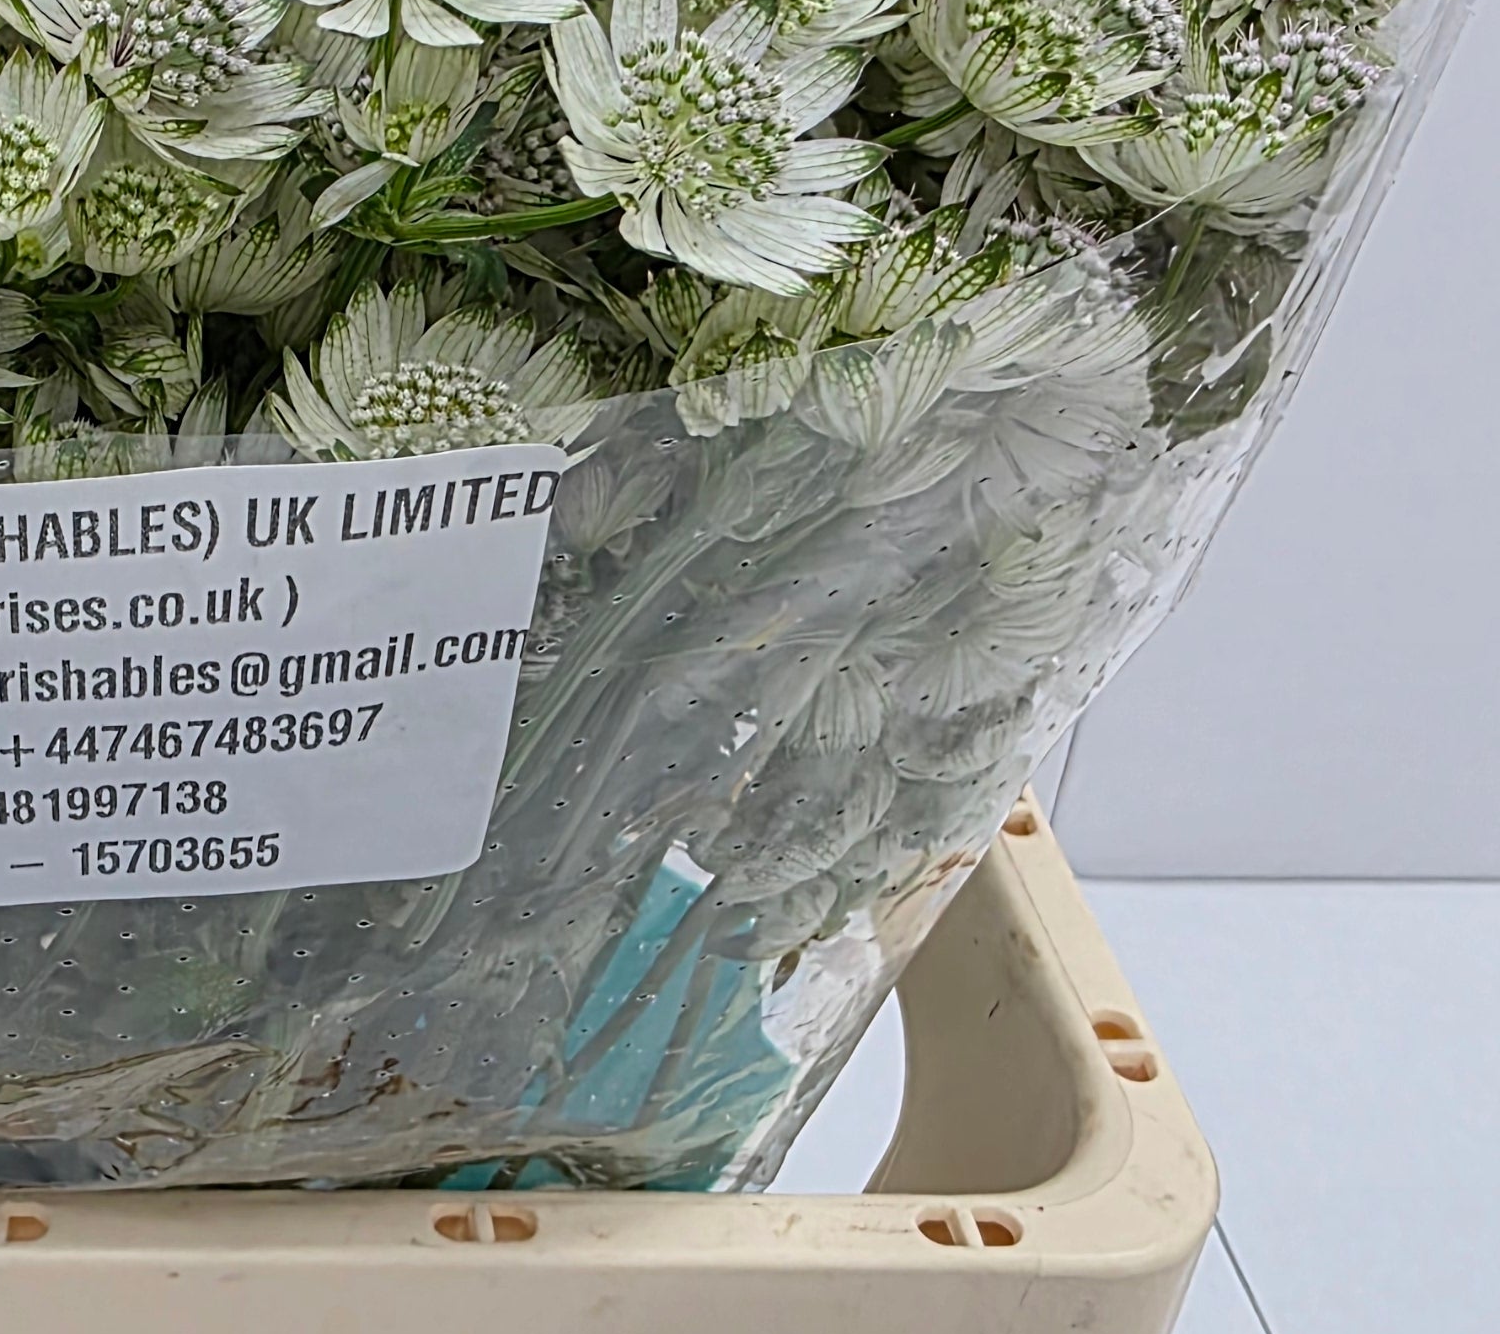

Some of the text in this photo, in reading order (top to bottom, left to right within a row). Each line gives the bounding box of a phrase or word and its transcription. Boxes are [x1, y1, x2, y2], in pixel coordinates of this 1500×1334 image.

[247, 495, 318, 547] UK
[341, 470, 561, 542] LIMITED
[281, 576, 299, 626] )
[0, 703, 384, 768] +447467483697
[72, 833, 280, 876] 15703655
